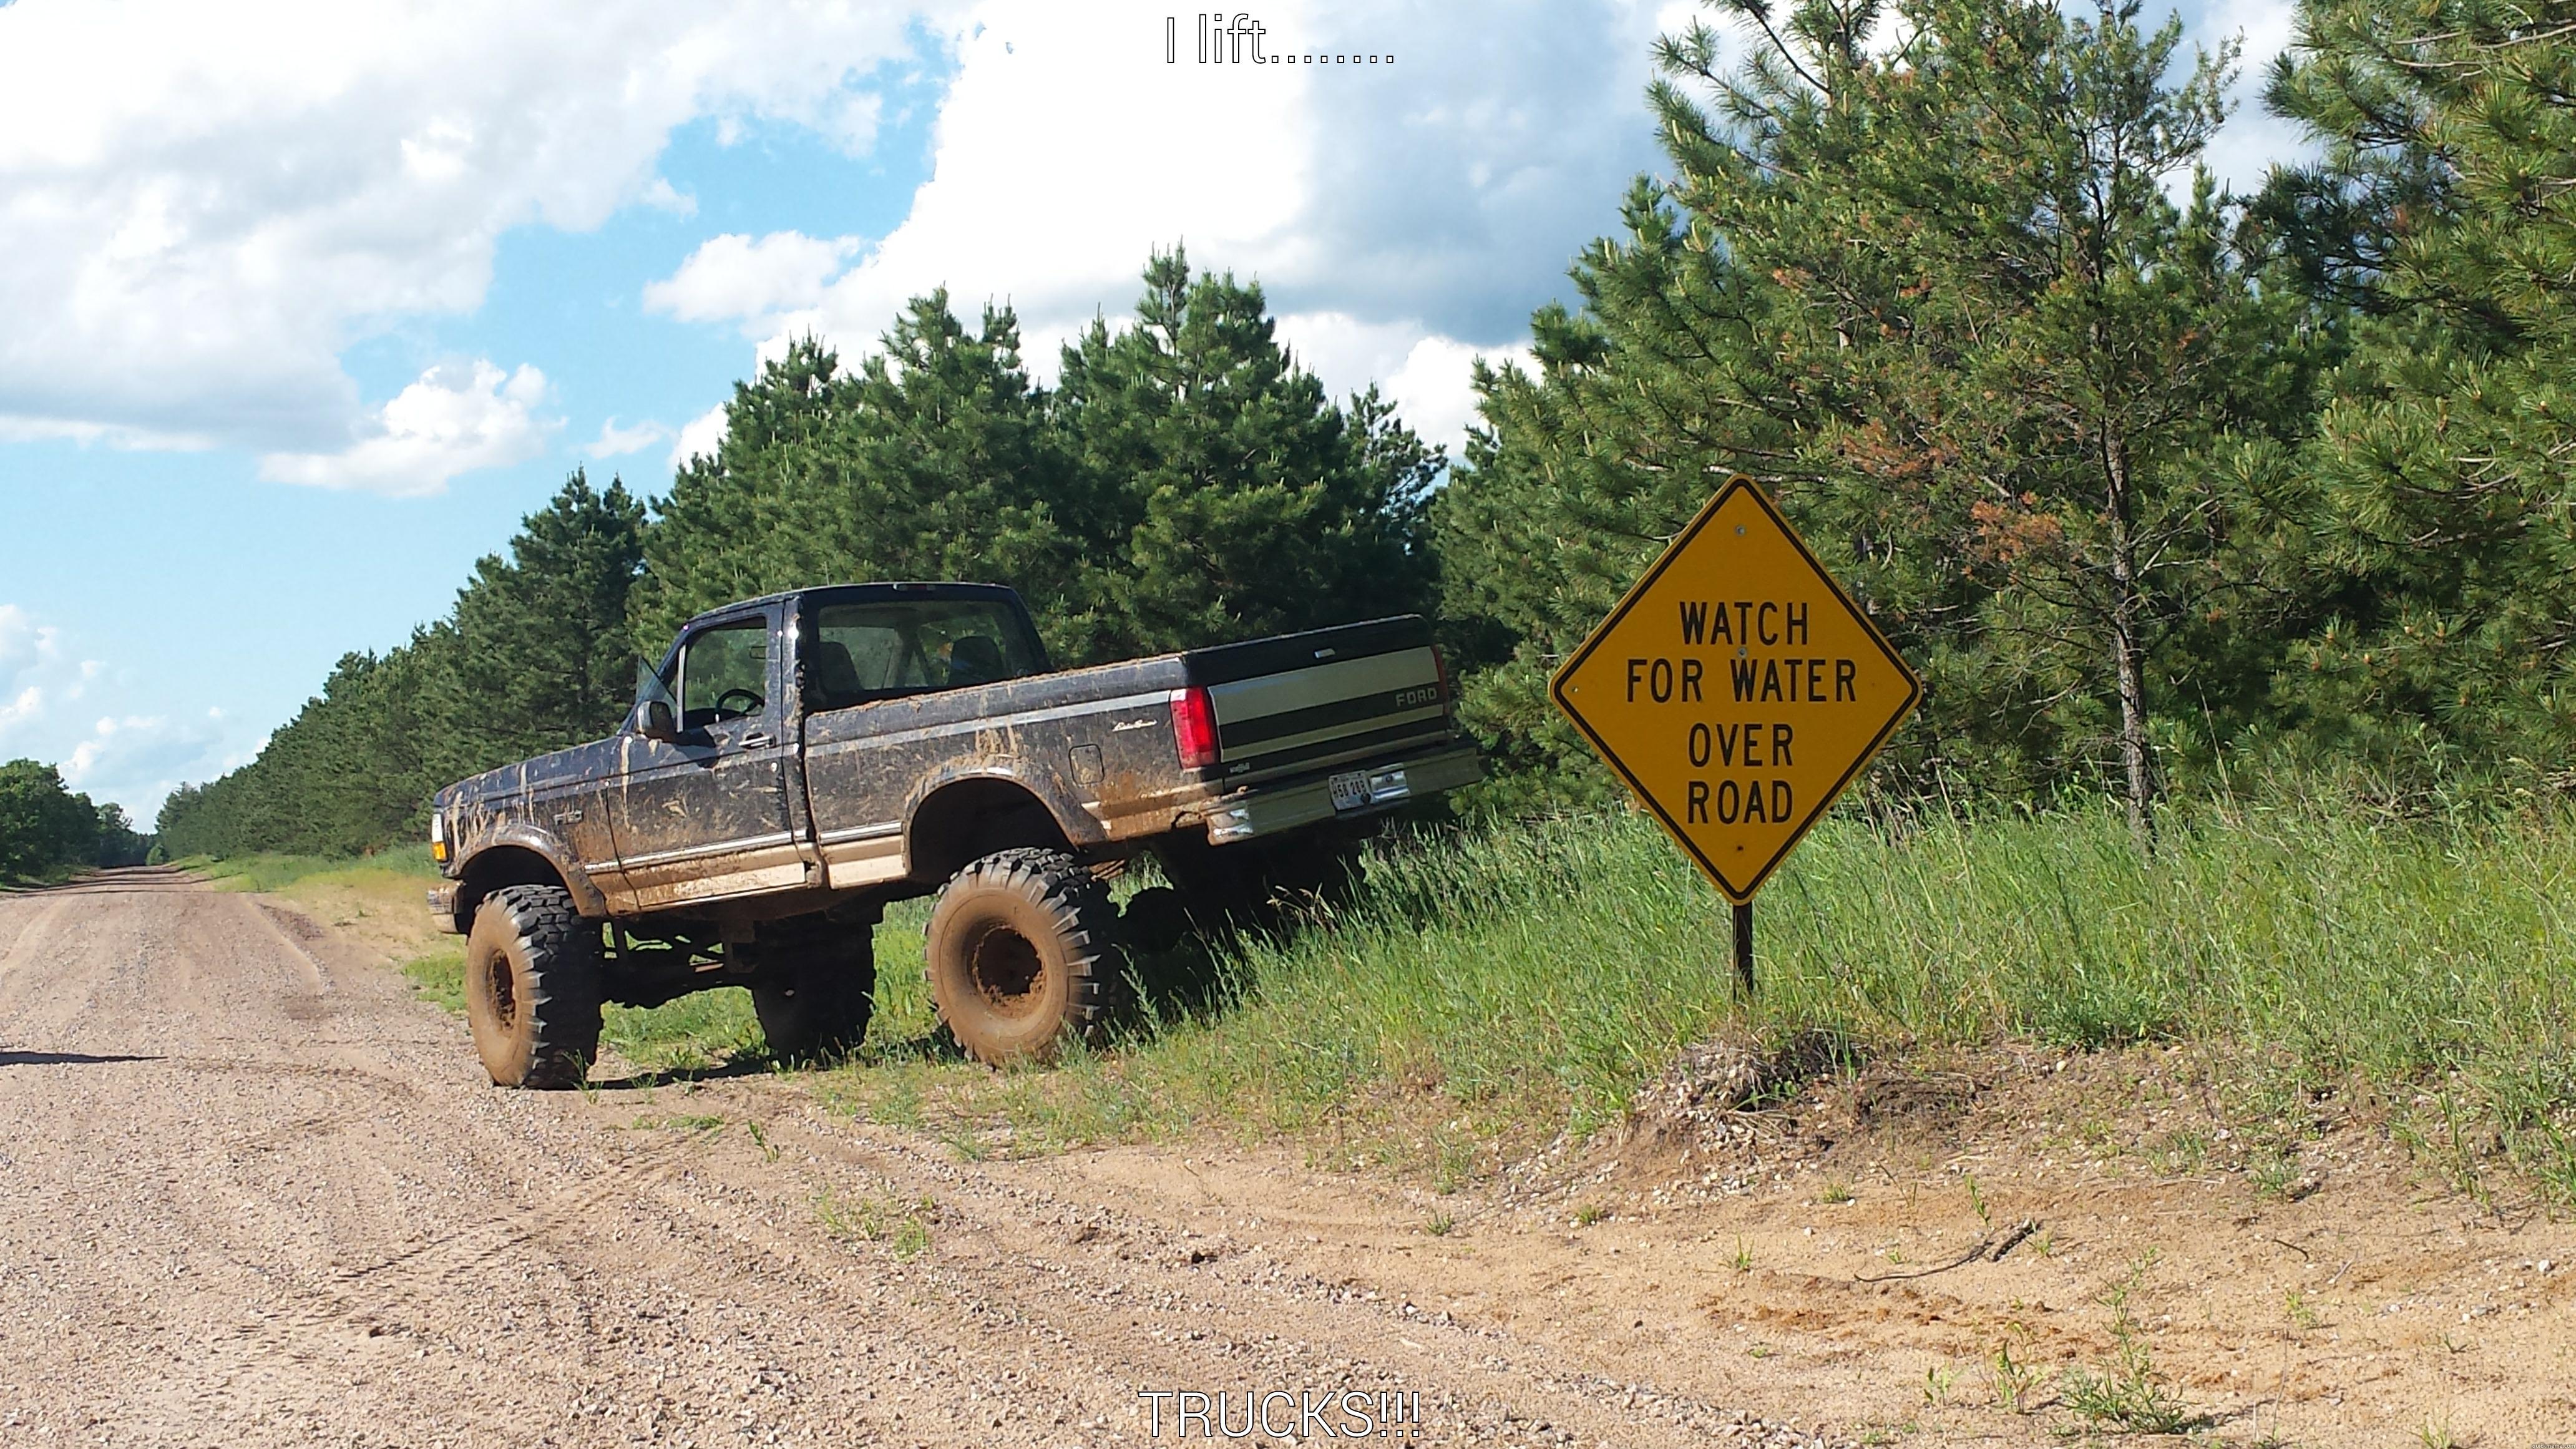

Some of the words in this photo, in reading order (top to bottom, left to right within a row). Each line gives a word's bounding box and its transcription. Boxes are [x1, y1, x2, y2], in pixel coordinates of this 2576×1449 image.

[1679, 602, 1807, 645] WATCH
[1395, 687, 1437, 707] FORD
[1627, 658, 1703, 703] FOR
[1730, 659, 1856, 703] WATER
[1689, 723, 1793, 767] OVER
[1688, 780, 1792, 824] ROAD
